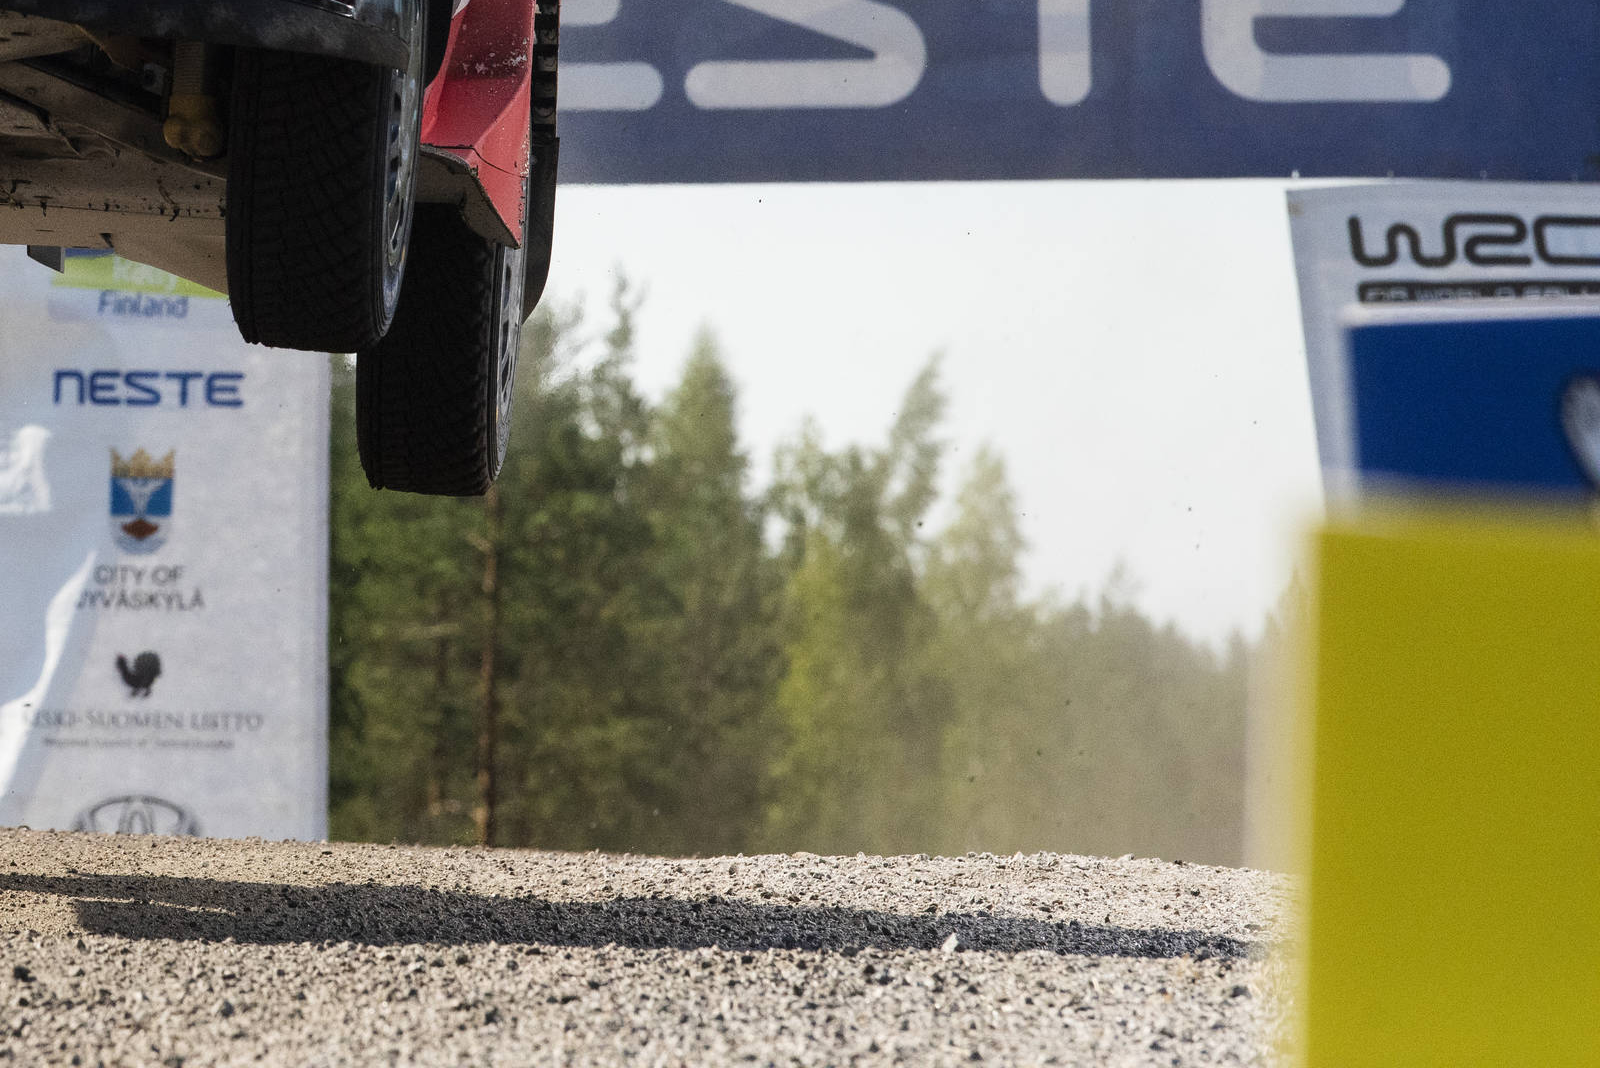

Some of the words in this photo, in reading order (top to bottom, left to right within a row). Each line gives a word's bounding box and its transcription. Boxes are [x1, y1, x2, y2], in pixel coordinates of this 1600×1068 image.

[98, 290, 188, 319] Finland
[53, 369, 245, 409] NESTE
[93, 564, 147, 585] CITY
[151, 564, 185, 586] OF
